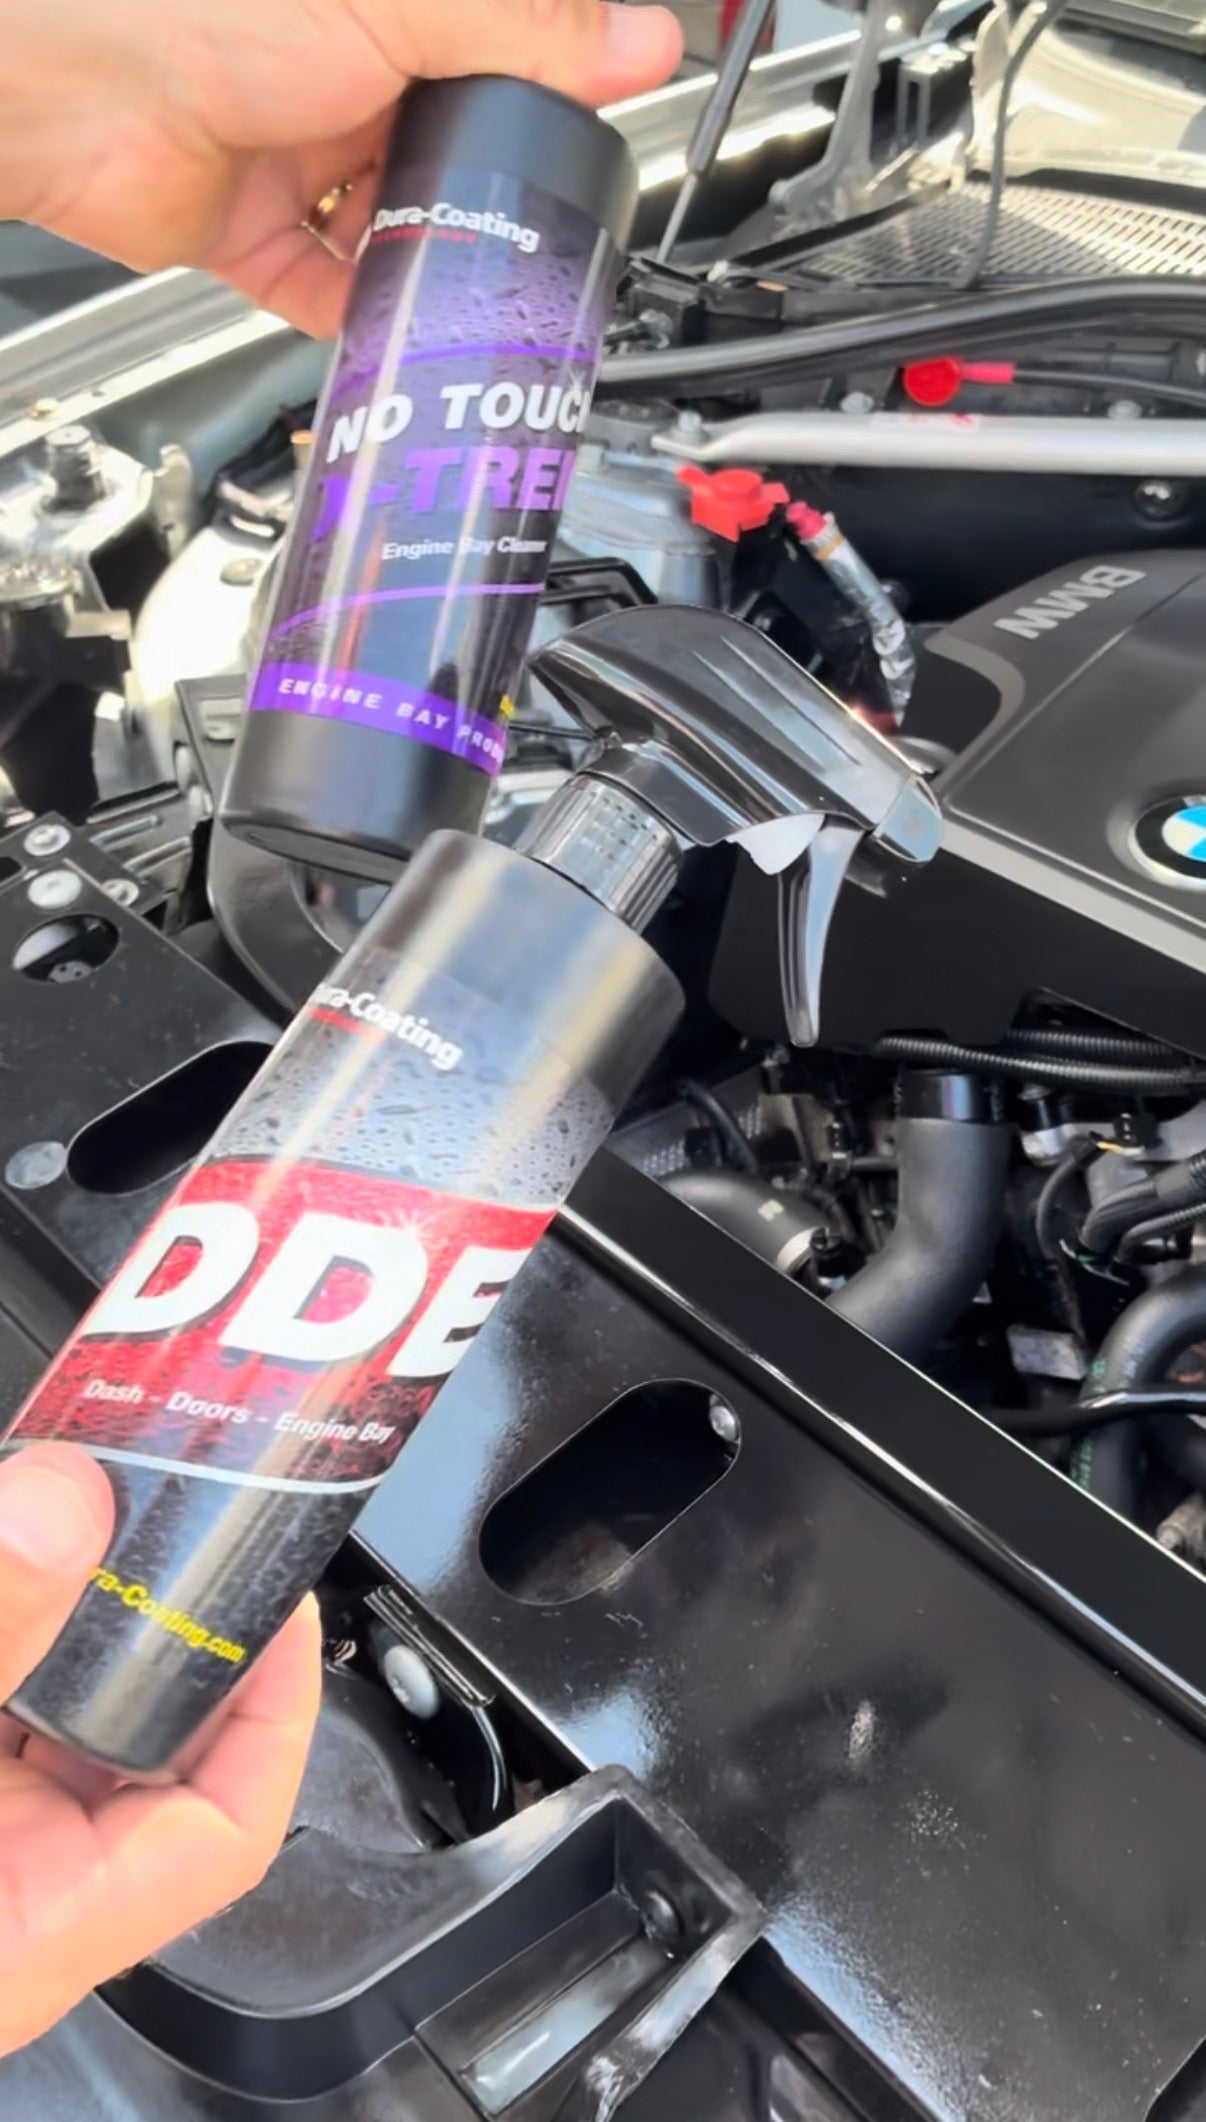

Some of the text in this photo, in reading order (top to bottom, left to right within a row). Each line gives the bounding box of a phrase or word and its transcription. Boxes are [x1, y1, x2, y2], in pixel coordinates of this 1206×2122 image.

[326, 394, 413, 464] NO
[381, 539, 454, 560] Engine
[459, 537, 495, 557] Bay
[993, 565, 1147, 640] BMW
[278, 678, 383, 710] ENGINE
[395, 702, 450, 730] BAY
[80, 1202, 533, 1378] DDE
[83, 1379, 145, 1405] Dash
[165, 1391, 252, 1424] Doors
[273, 1411, 358, 1442] Engine
[357, 1421, 396, 1445] Bay
